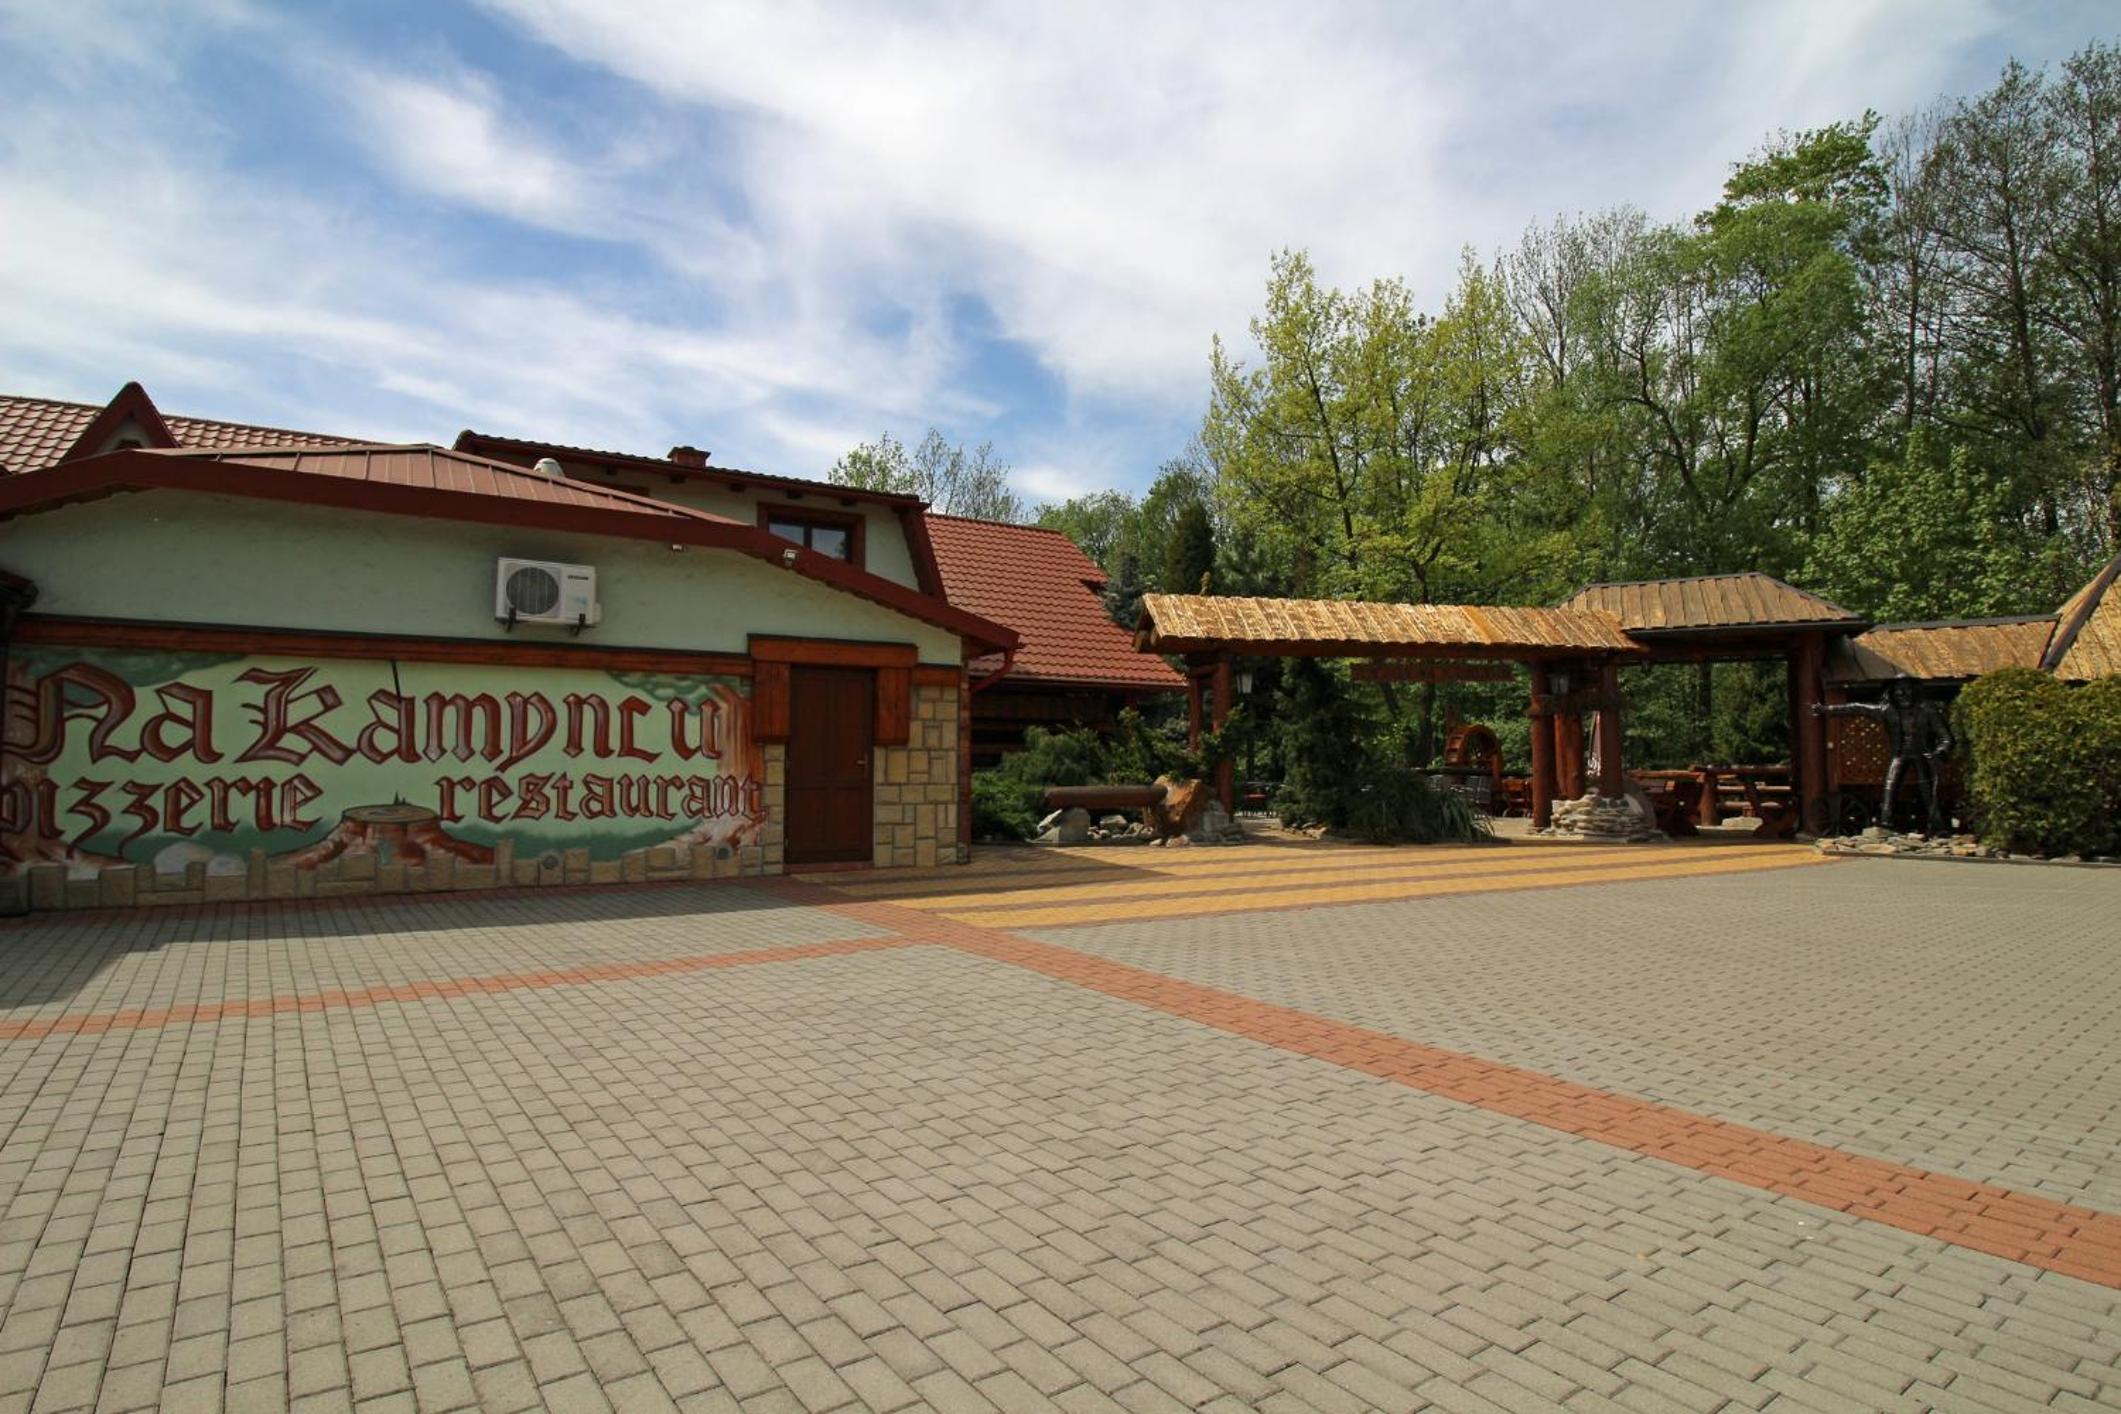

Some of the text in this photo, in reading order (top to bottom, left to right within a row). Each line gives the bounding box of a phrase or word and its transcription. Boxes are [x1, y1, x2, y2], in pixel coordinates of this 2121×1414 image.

[0, 661, 722, 773] Na Kamyncu
[434, 771, 766, 823] restaurant
